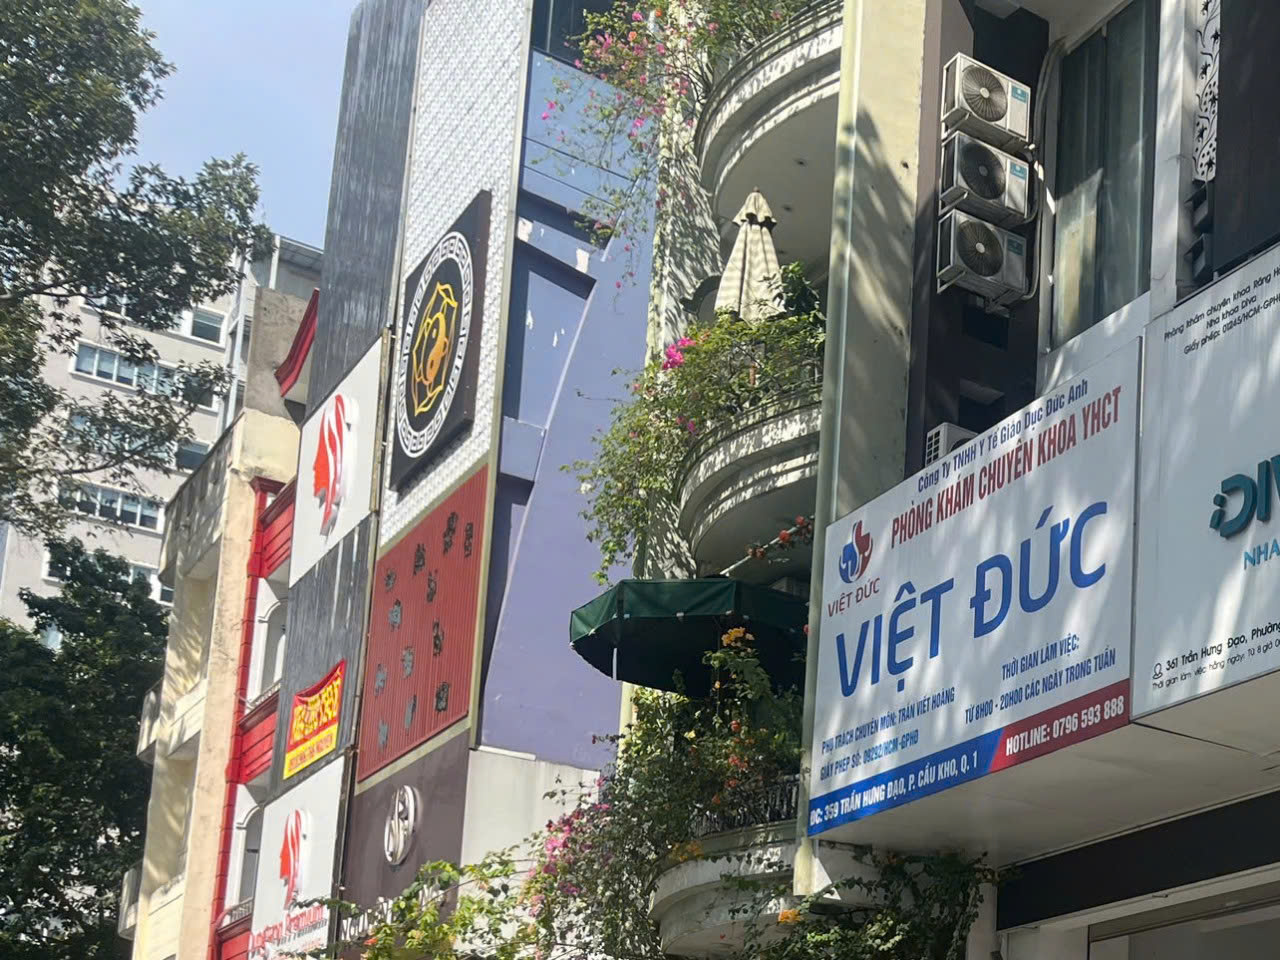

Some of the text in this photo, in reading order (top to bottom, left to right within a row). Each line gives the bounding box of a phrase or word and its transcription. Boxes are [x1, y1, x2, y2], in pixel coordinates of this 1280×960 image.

[918, 468, 940, 493] Công
[942, 460, 951, 479] Ty
[953, 449, 977, 472] TNHH
[979, 440, 985, 457] Y
[987, 428, 998, 452] Tế
[1024, 407, 1043, 432] Dục
[1045, 391, 1066, 418] Đức
[1068, 379, 1089, 405] Anh
[891, 385, 1122, 550] PHÒNG KHÁM CHUYÊN KHOA YHCT
[1244, 539, 1280, 570] NHA
[828, 577, 881, 617] VIỆT ĐỨC
[835, 501, 1108, 697] VIỆT ĐỨC
[1002, 656, 1019, 681] THỜI
[1020, 649, 1039, 674] GIAN
[1040, 640, 1057, 665] LÀM
[1024, 677, 1041, 700] CÁC
[1042, 668, 1063, 694] NGÀY
[1065, 658, 1092, 683] TRONG
[1166, 658, 1180, 671] 361
[1182, 650, 1198, 667] Trần
[1201, 642, 1222, 659] Hưng
[1006, 695, 1124, 757] HOTLINE: 0796 593 888
[823, 803, 839, 822] 359
[840, 789, 861, 815] TRẦN
[862, 783, 885, 808] HƯNG
[917, 762, 936, 788] CẦU
[973, 750, 978, 769] 1
